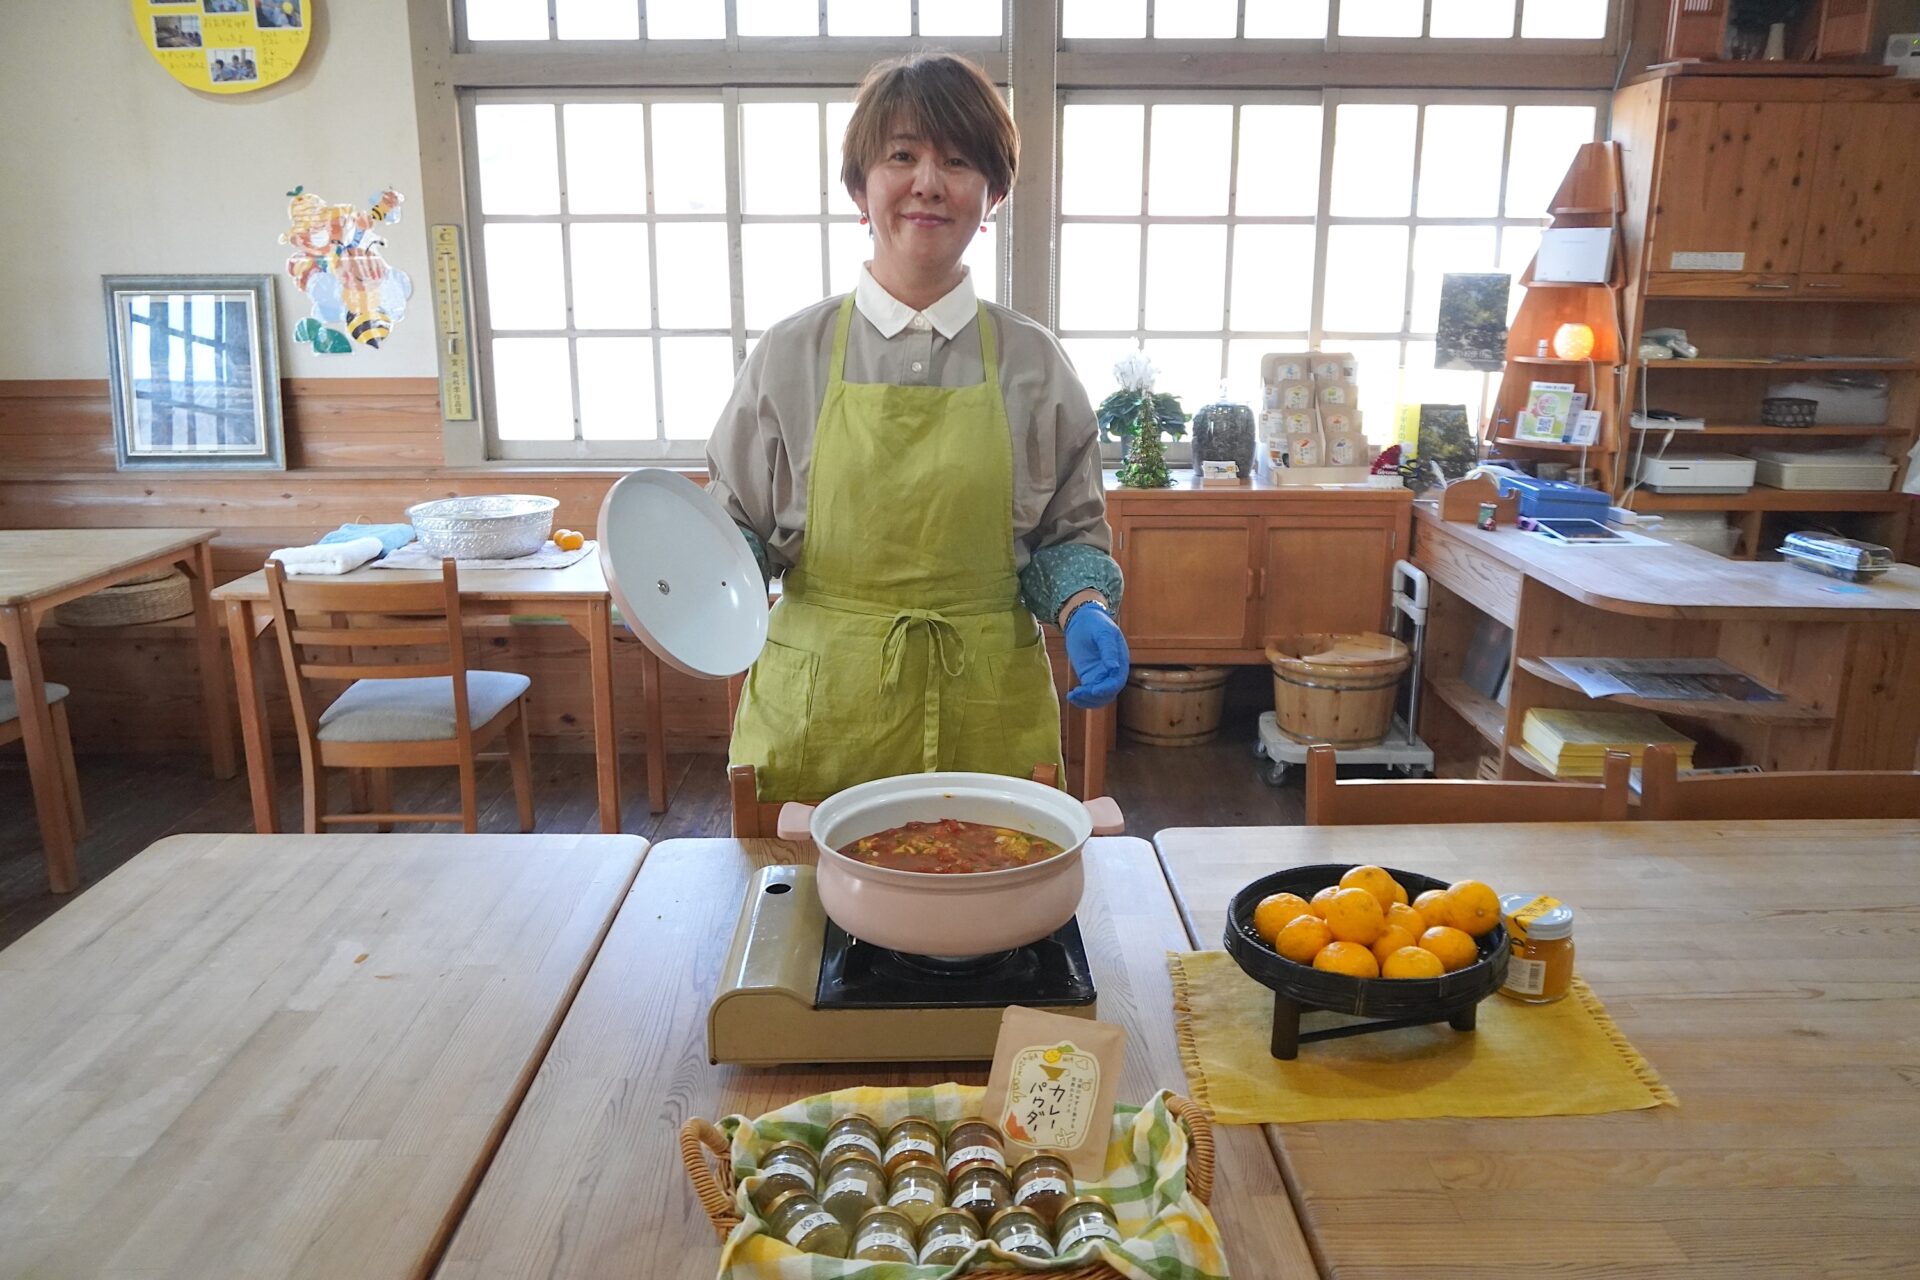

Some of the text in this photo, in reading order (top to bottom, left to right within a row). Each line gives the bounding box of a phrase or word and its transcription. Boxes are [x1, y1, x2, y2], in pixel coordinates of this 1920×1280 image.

[1026, 1081, 1048, 1132] パウダー
[1048, 1083, 1066, 1129] カレー
